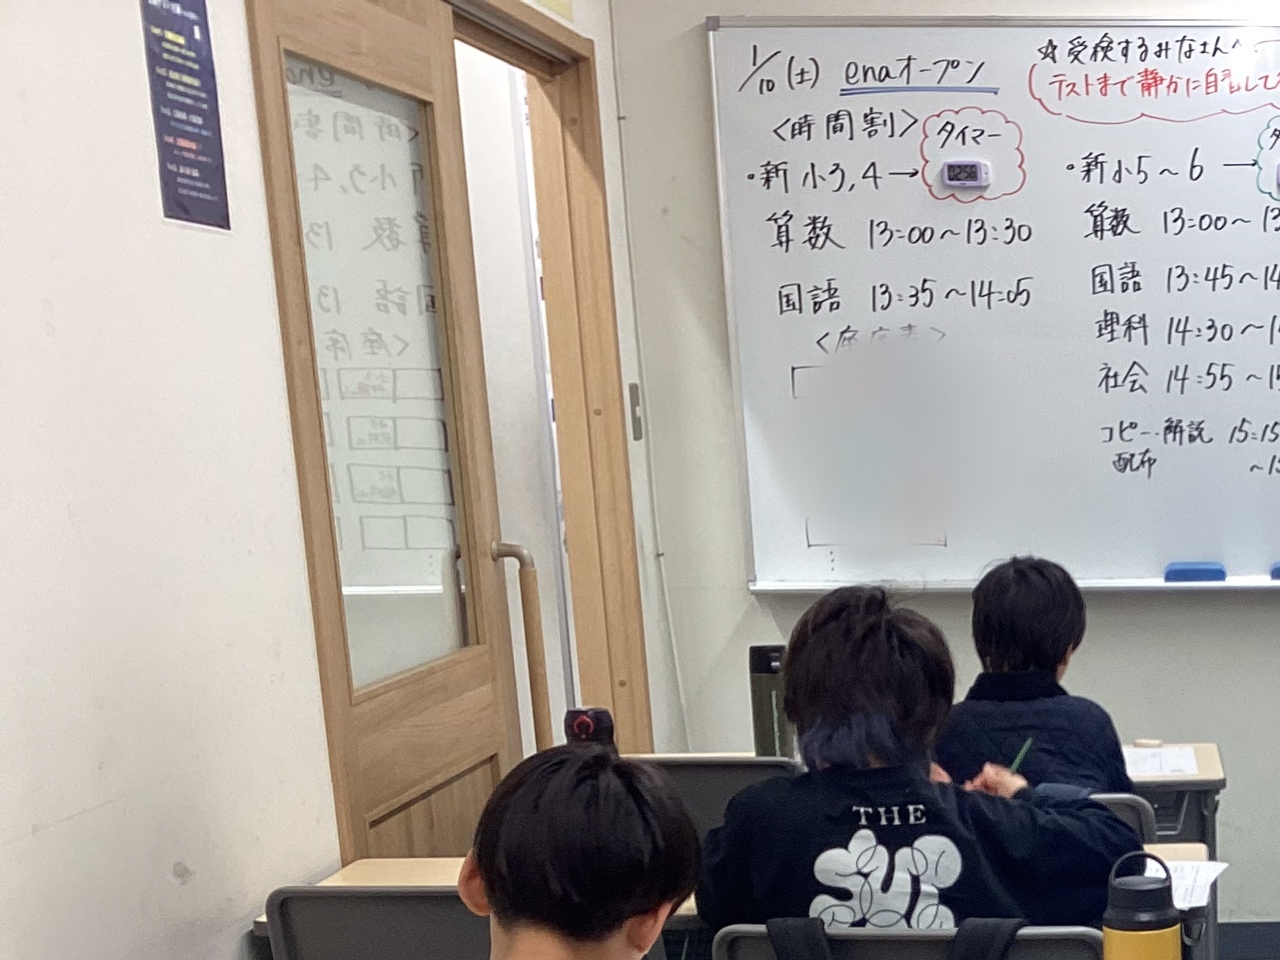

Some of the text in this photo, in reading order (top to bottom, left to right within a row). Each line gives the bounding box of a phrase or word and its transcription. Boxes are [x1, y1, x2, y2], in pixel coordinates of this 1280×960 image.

[937, 121, 1001, 148] タイマー
[765, 210, 846, 253] 算数
[1084, 201, 1141, 240] 算数
[1092, 262, 1142, 295] 国語
[778, 278, 840, 315] 国語
[1095, 309, 1149, 346] 理科
[1098, 361, 1149, 394] 社会
[1112, 448, 1157, 479] 配布
[852, 804, 926, 825] THE
